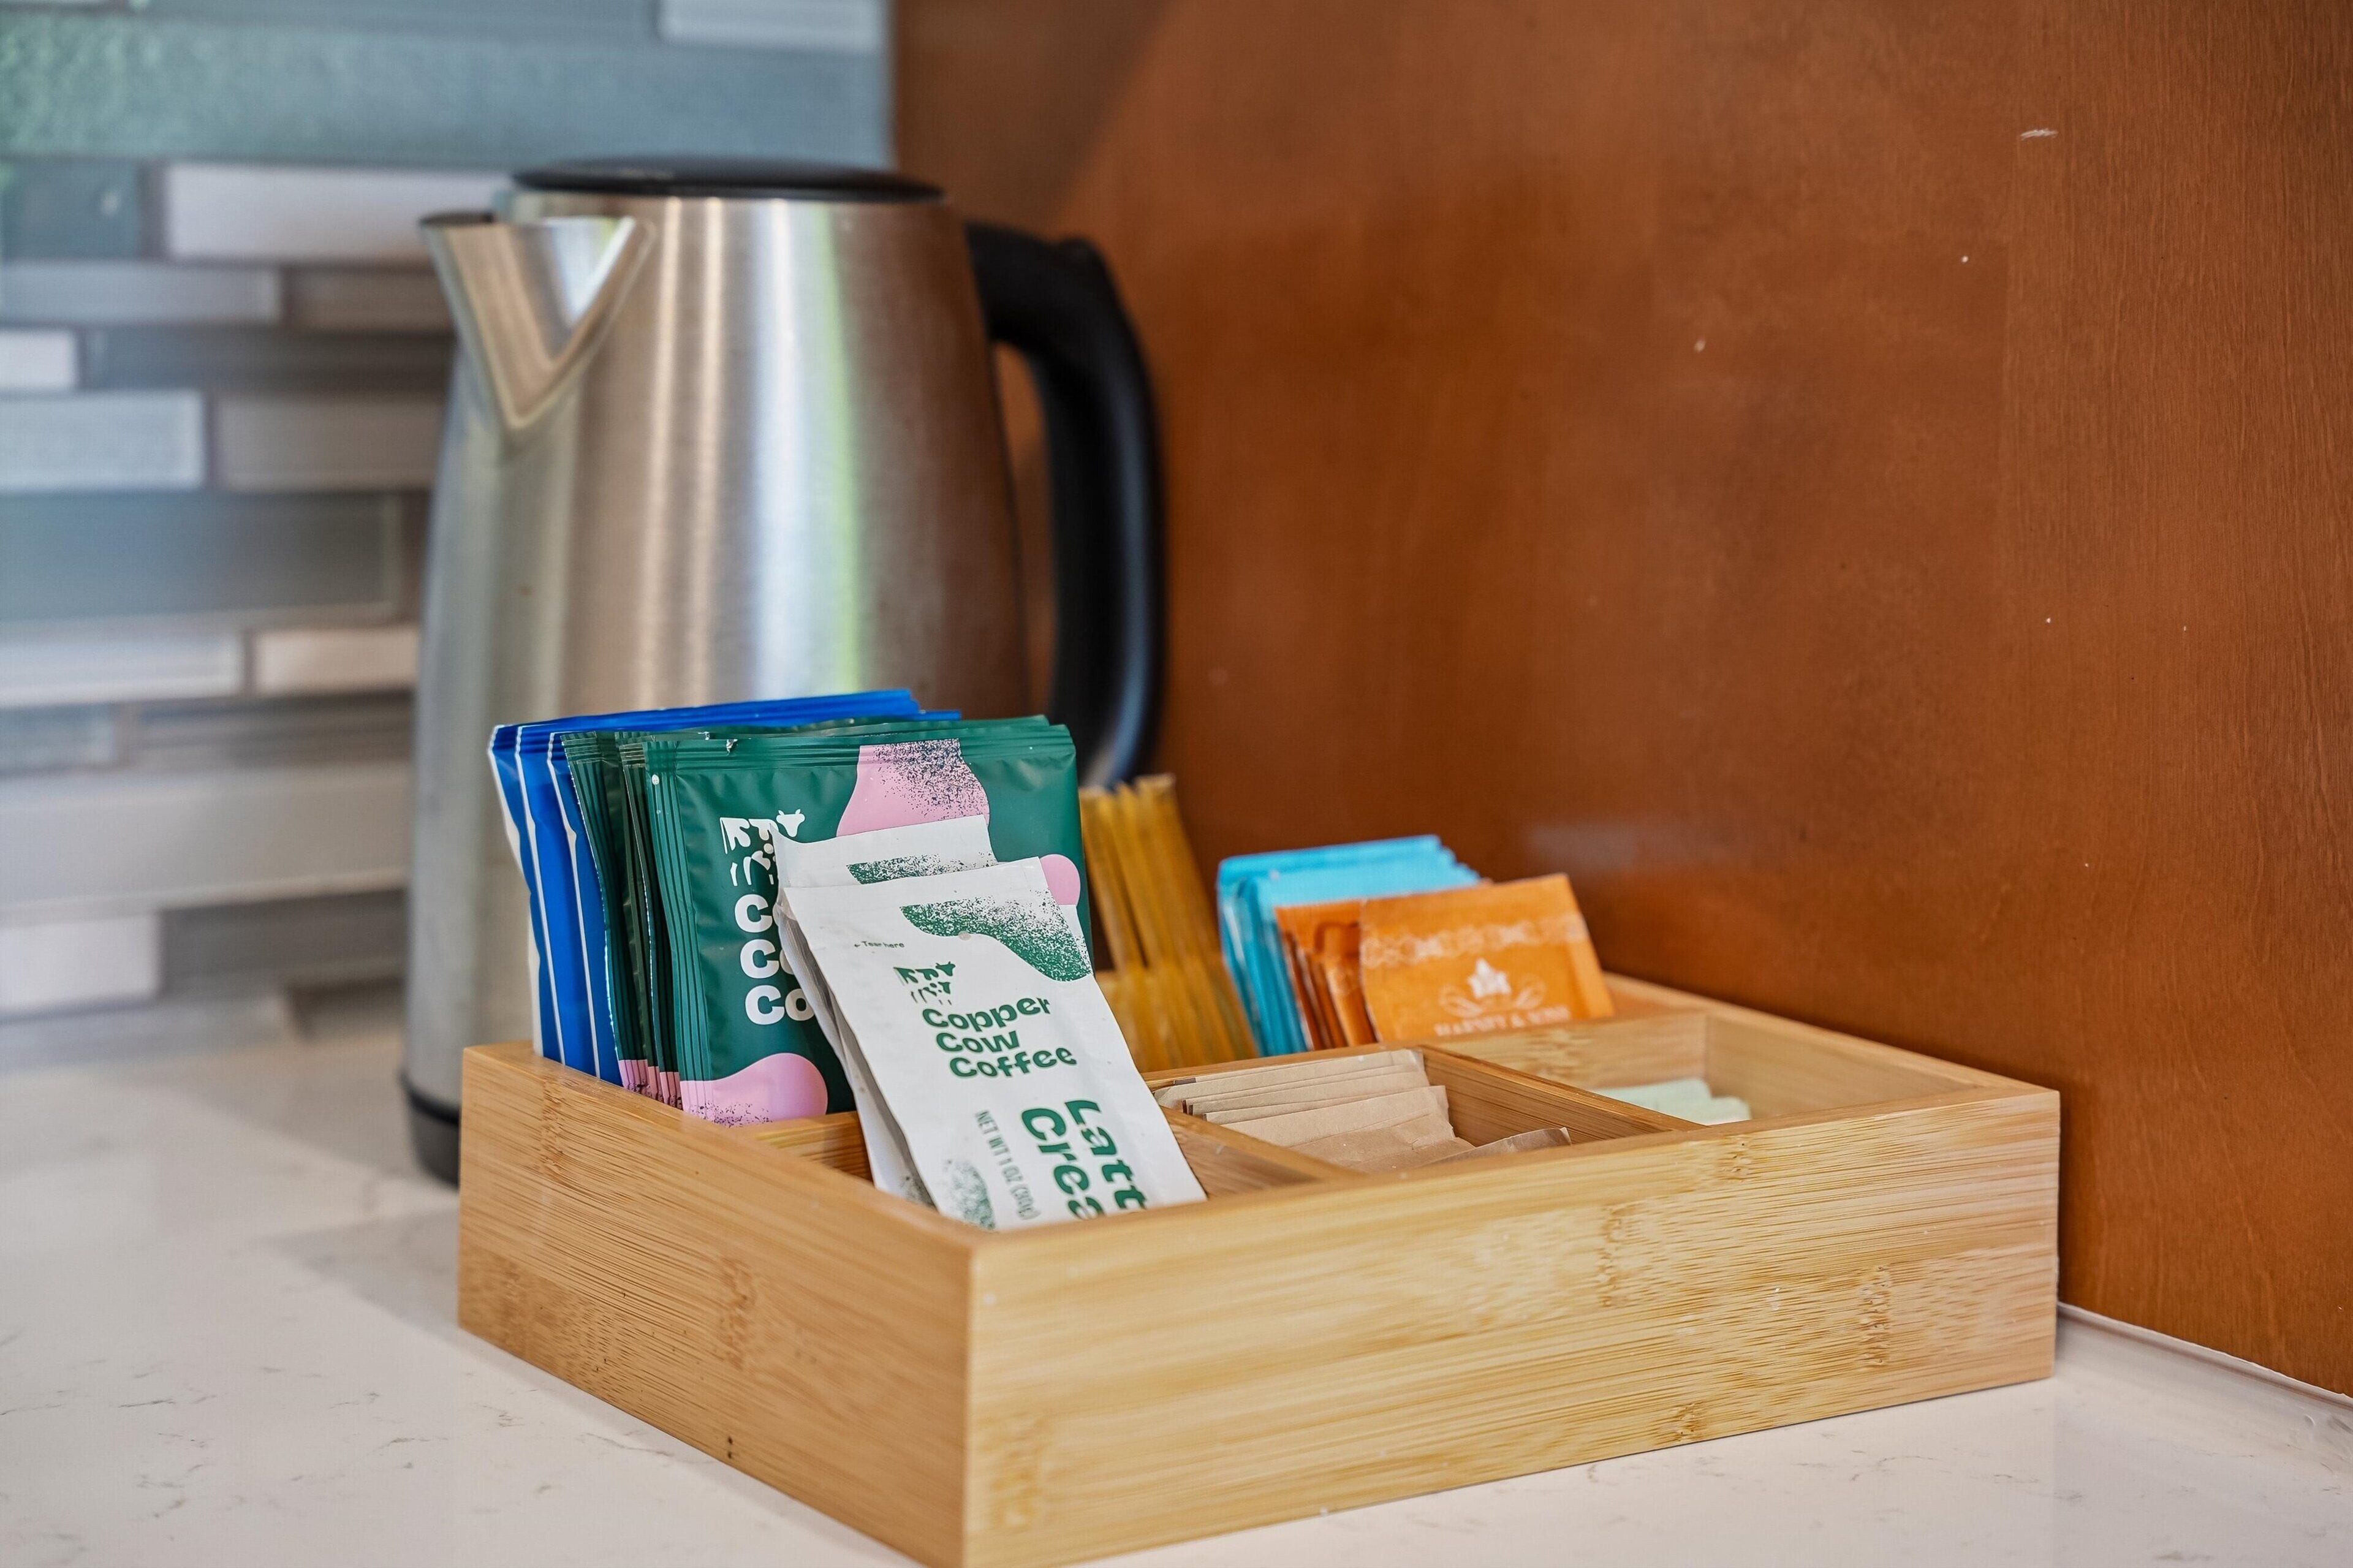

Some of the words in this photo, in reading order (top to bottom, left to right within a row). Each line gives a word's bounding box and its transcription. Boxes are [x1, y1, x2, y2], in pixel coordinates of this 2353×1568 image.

[922, 998, 1050, 1032] Copper
[936, 1031, 1020, 1053] Cow
[950, 1047, 1077, 1078] Coffee
[976, 1111, 998, 1134] NET
[989, 1137, 1009, 1156] WT
